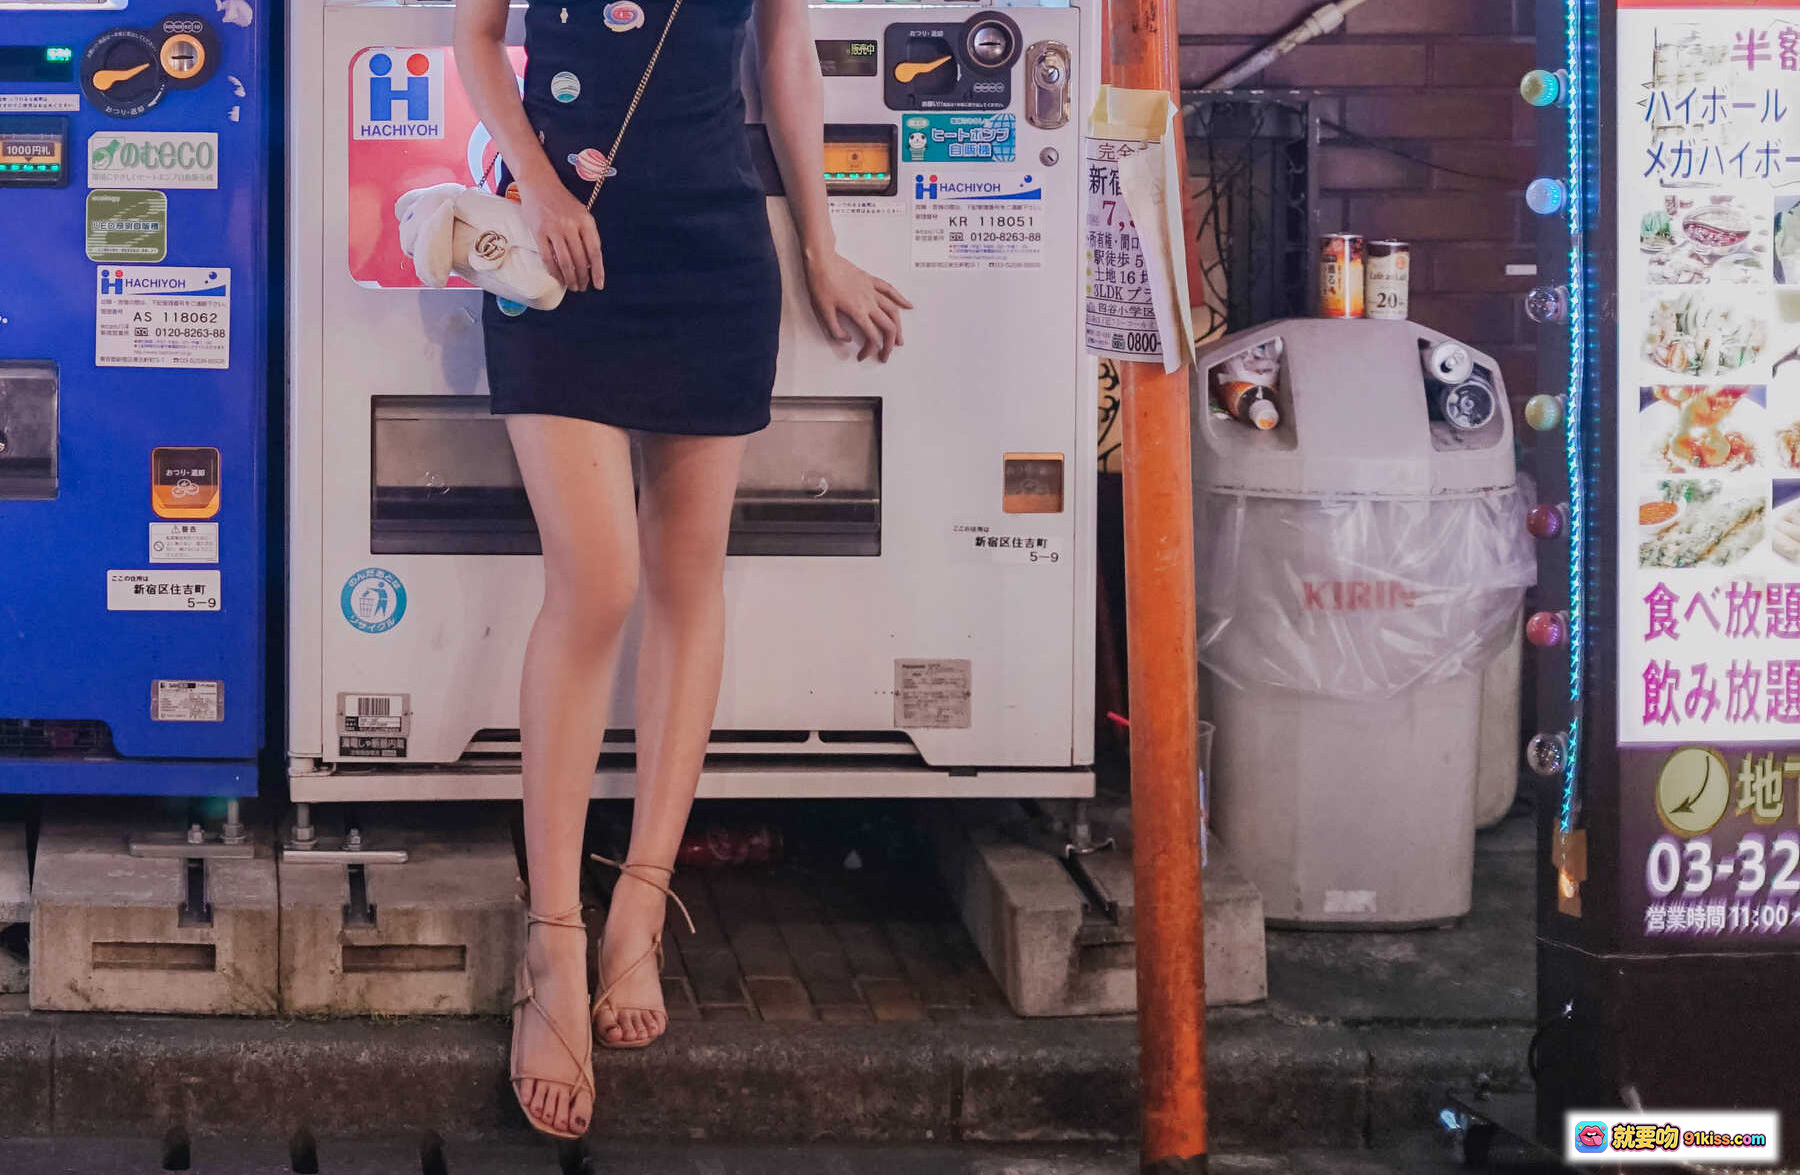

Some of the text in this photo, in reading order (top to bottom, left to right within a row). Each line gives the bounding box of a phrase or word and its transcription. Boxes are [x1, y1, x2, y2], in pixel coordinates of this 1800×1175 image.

[1644, 87, 1788, 125] ハイボール
[360, 123, 439, 137] HACHIYOH
[931, 127, 1010, 143] ヒートポンプ
[6, 144, 52, 156] 1000円札
[939, 183, 1001, 193] HACHIYOH
[949, 216, 1034, 227] KR 118051
[970, 232, 1041, 242] 0120-8263-88
[125, 278, 186, 289] HACHIYOH
[1376, 292, 1398, 309] 20
[133, 311, 218, 324] AS 118062
[155, 328, 226, 338] 0120-8263-88
[975, 536, 1048, 549] 新宿区住吉町
[134, 583, 207, 596] 新宿区住吉町
[1642, 581, 1800, 642] 食べ放題
[1642, 658, 1800, 727] 飲み放題
[1646, 904, 1726, 931] 営業時間
